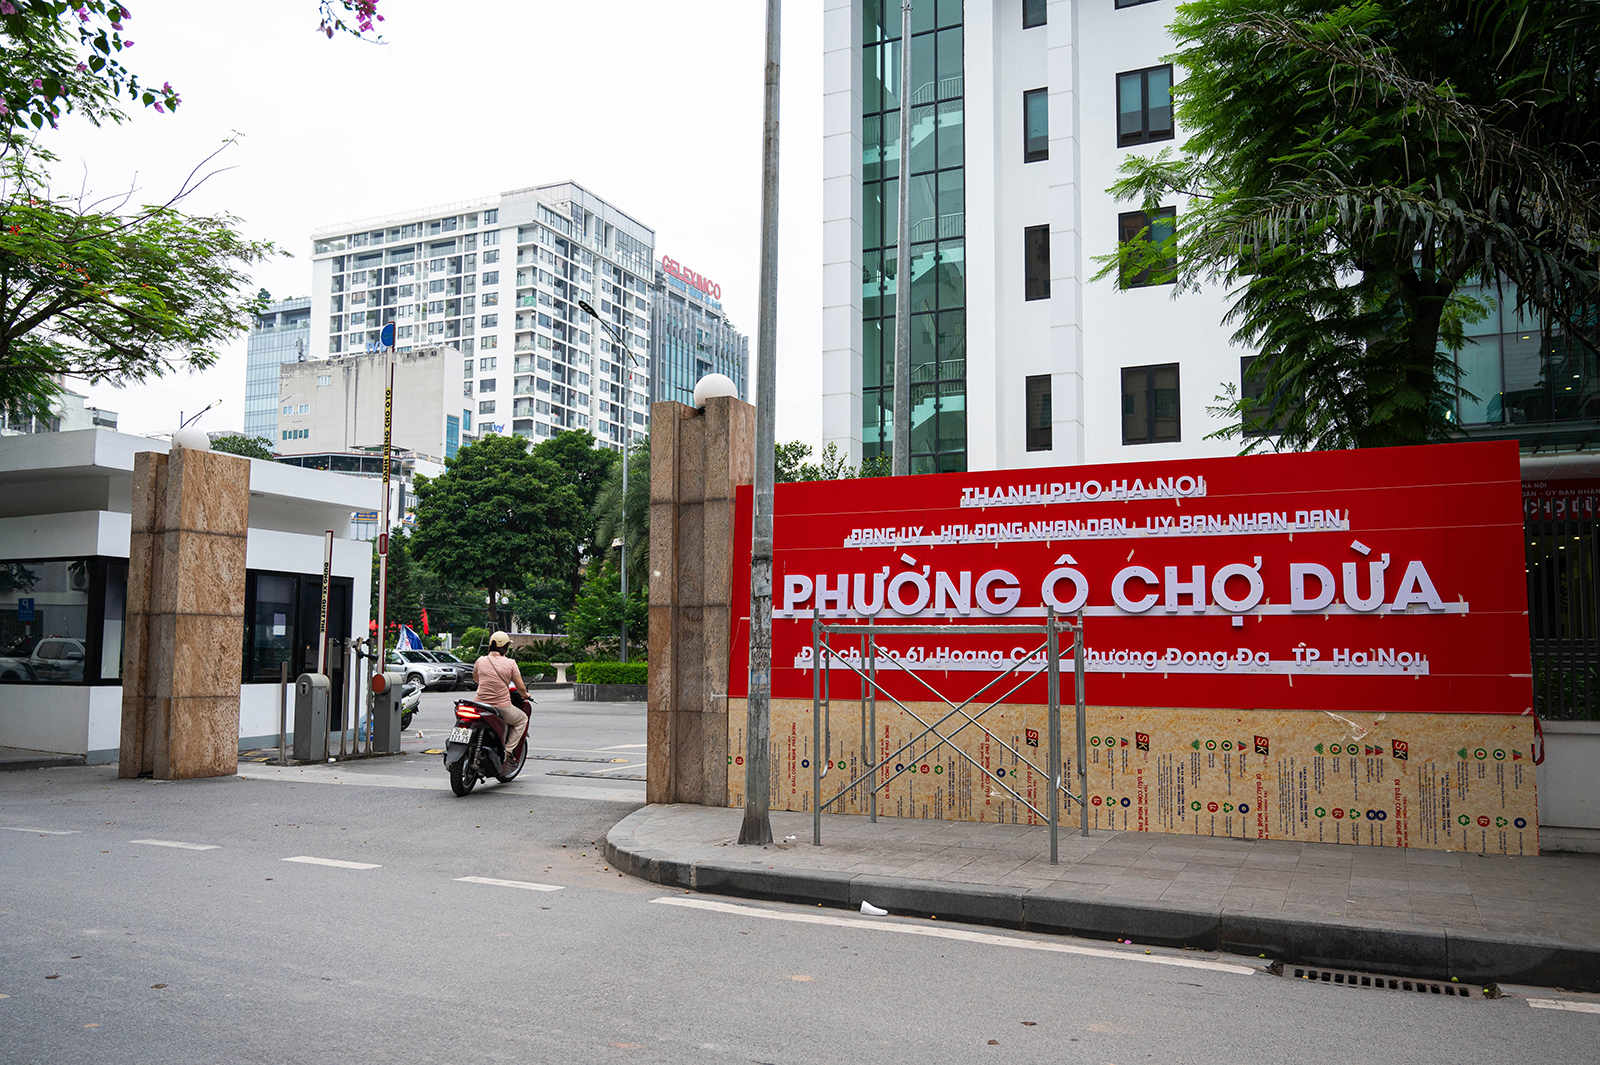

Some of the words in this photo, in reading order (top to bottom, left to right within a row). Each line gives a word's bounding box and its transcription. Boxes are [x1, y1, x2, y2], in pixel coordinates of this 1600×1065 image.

[662, 255, 721, 300] GELEXIMCO
[962, 484, 1041, 506] THANH
[1050, 480, 1102, 501] PHO
[1111, 479, 1148, 500] HA
[1156, 475, 1204, 497] NOI
[940, 524, 969, 541] HOI
[1028, 520, 1081, 539] NHAN
[1086, 517, 1127, 537] DAN
[1146, 516, 1173, 534] UY
[1179, 514, 1222, 533] BAN
[1229, 512, 1288, 531] NHAN
[1295, 509, 1340, 529] DAN
[901, 526, 924, 543] UY
[783, 553, 1021, 616] PHƯỜNG
[1041, 554, 1089, 613] Ô
[1111, 556, 1264, 626] CHỢ
[1290, 540, 1445, 612] DỪA
[801, 646, 832, 662] Đa
[906, 646, 924, 663] 61
[936, 646, 1003, 668] Hoang
[1083, 647, 1158, 669] hương
[1333, 648, 1368, 666] Ha
[1138, 734, 1148, 750] SK
[1256, 738, 1267, 753] SK
[1395, 742, 1407, 758] SK
